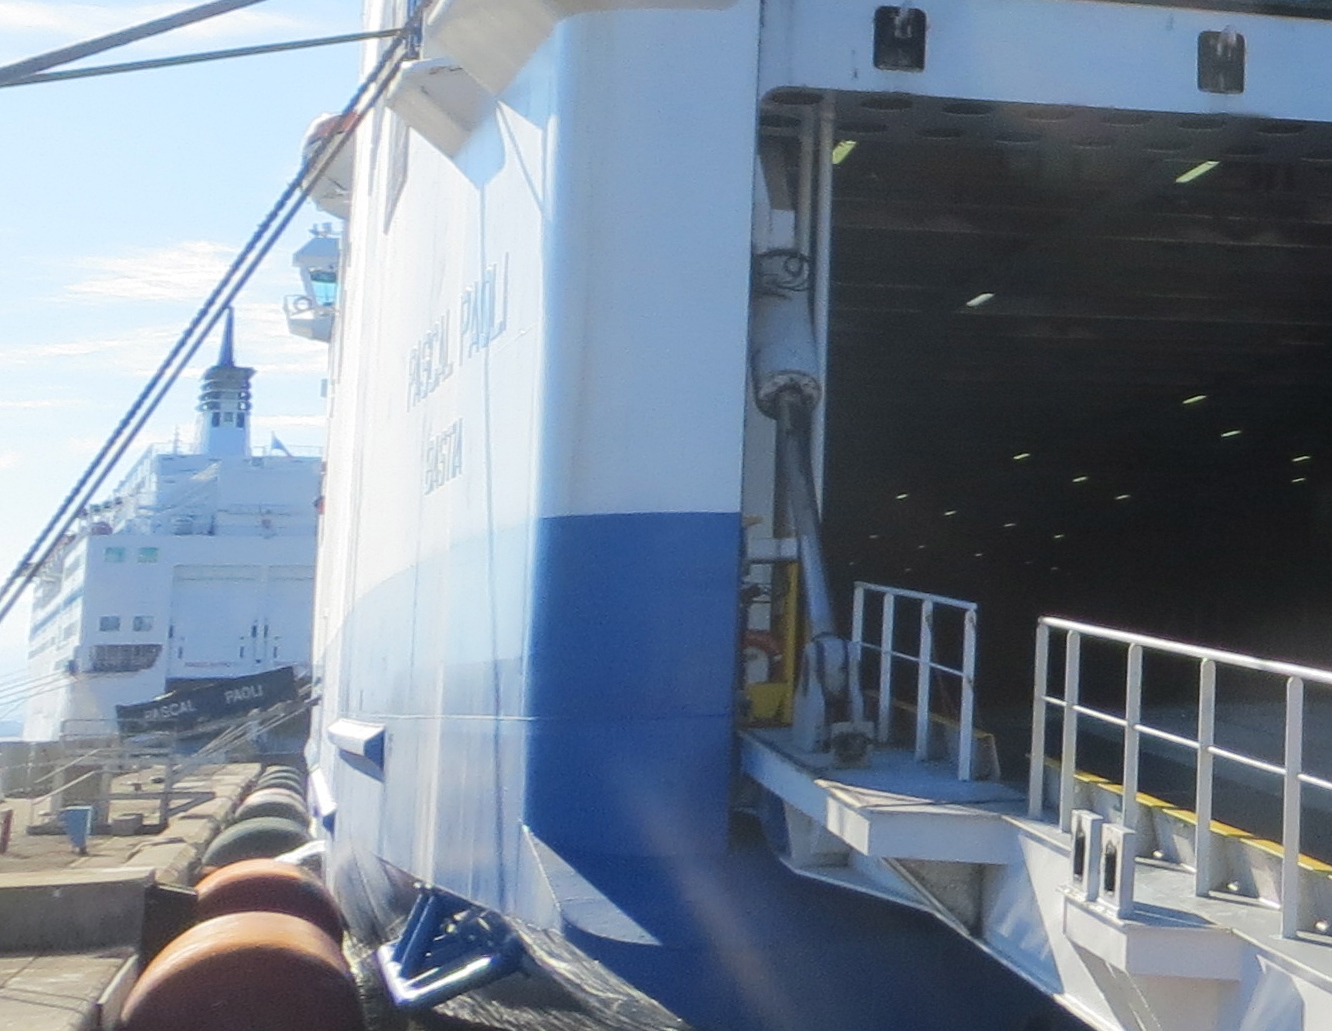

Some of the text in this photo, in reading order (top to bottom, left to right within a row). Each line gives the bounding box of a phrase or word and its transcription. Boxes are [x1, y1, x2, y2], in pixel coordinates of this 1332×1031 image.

[406, 251, 509, 413] PASCAL PAOLI
[143, 685, 264, 720] PASCAL PAOLI
